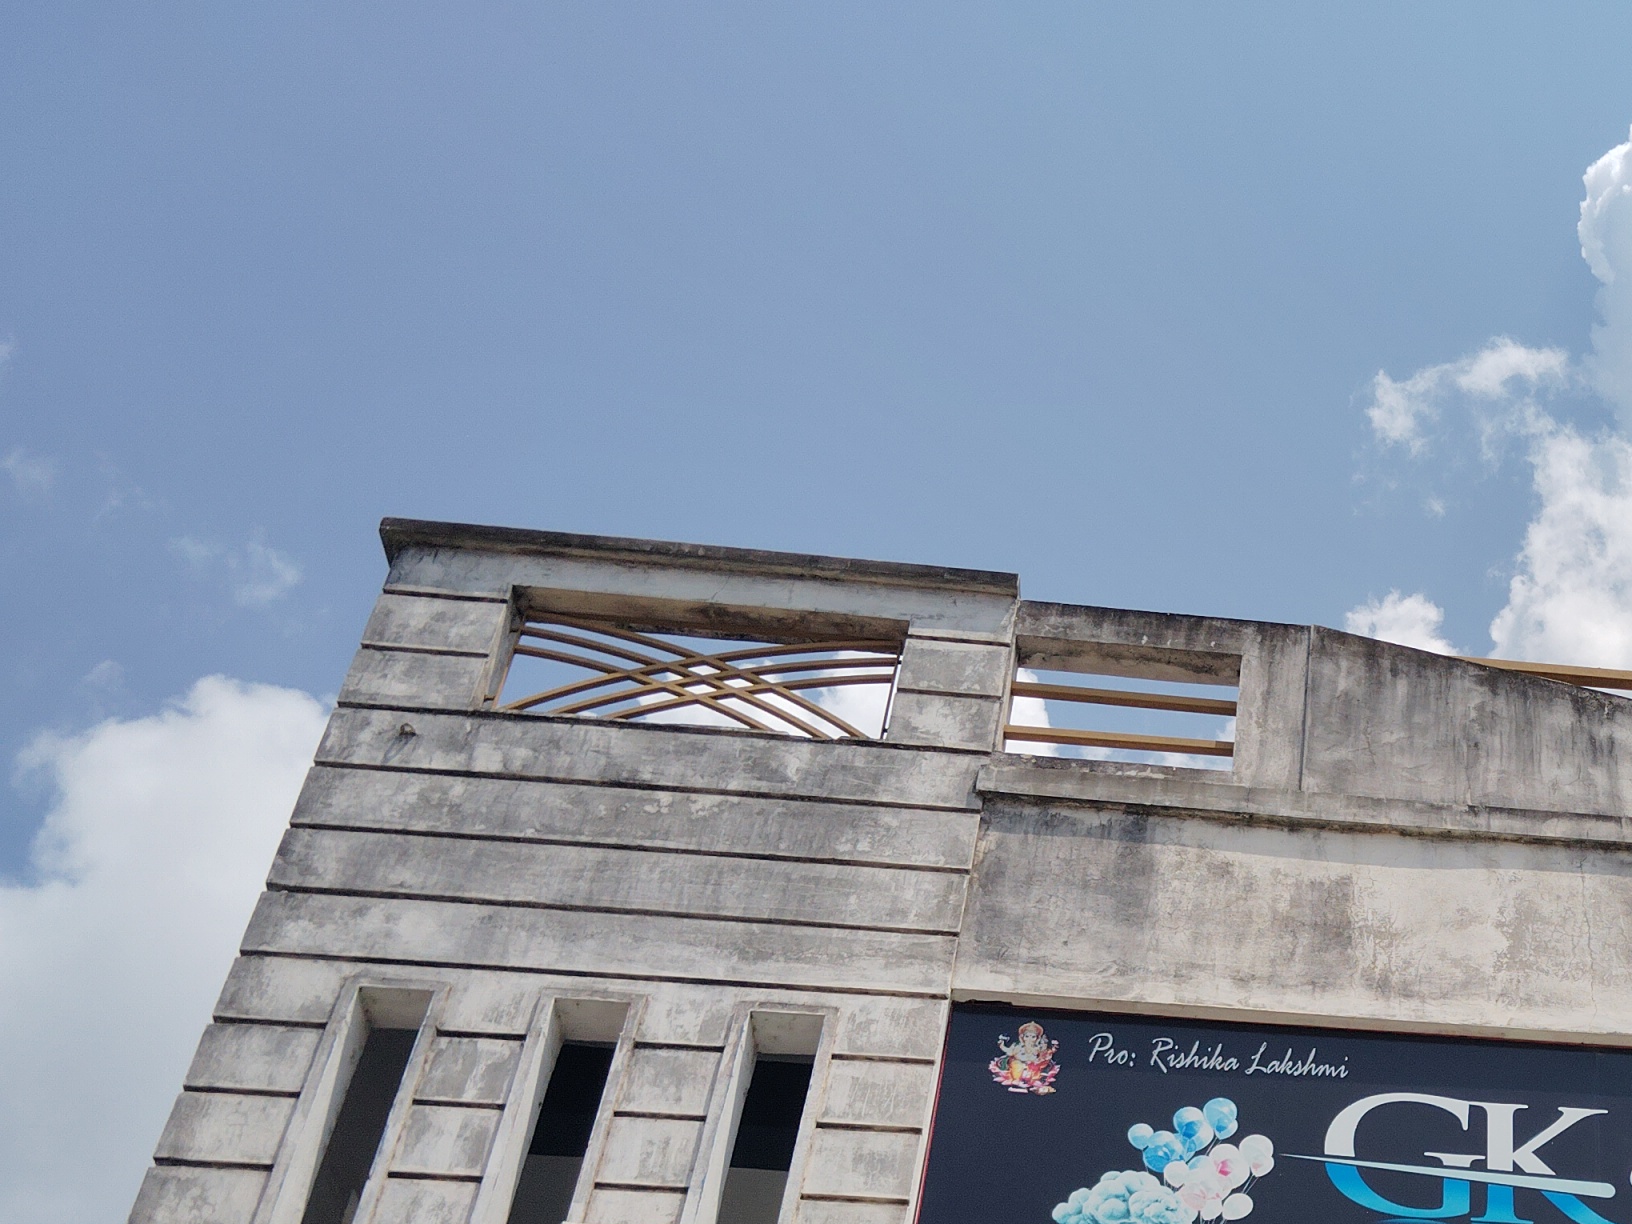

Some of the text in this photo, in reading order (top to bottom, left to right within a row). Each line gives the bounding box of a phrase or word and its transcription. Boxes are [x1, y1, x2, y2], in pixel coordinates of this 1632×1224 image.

[1088, 1032, 1349, 1079] Pro: Rishika Lakshmi
